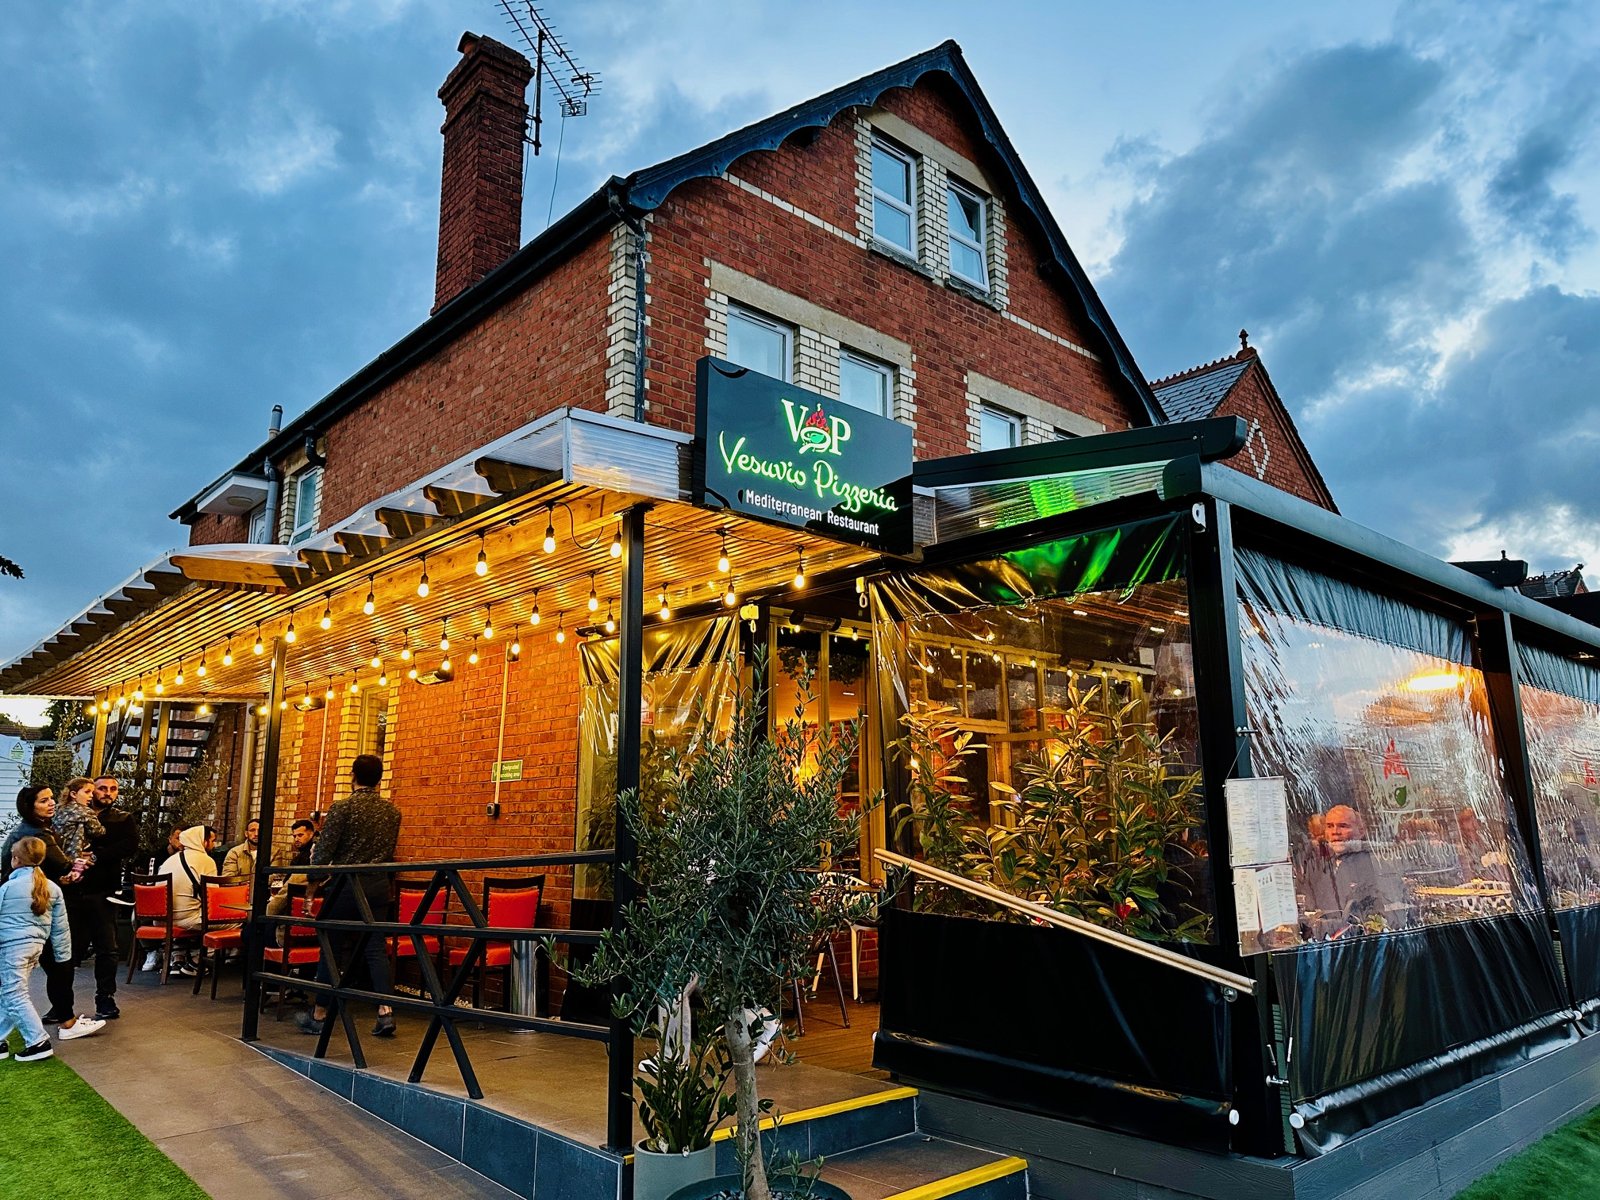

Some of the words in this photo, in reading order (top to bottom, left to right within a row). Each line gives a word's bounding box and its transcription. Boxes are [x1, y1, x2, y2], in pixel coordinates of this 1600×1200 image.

[719, 430, 807, 486] Vesuvio
[813, 459, 899, 513] Pizzeria
[746, 488, 823, 522] Mediterranean
[827, 511, 880, 536] Restaurant
